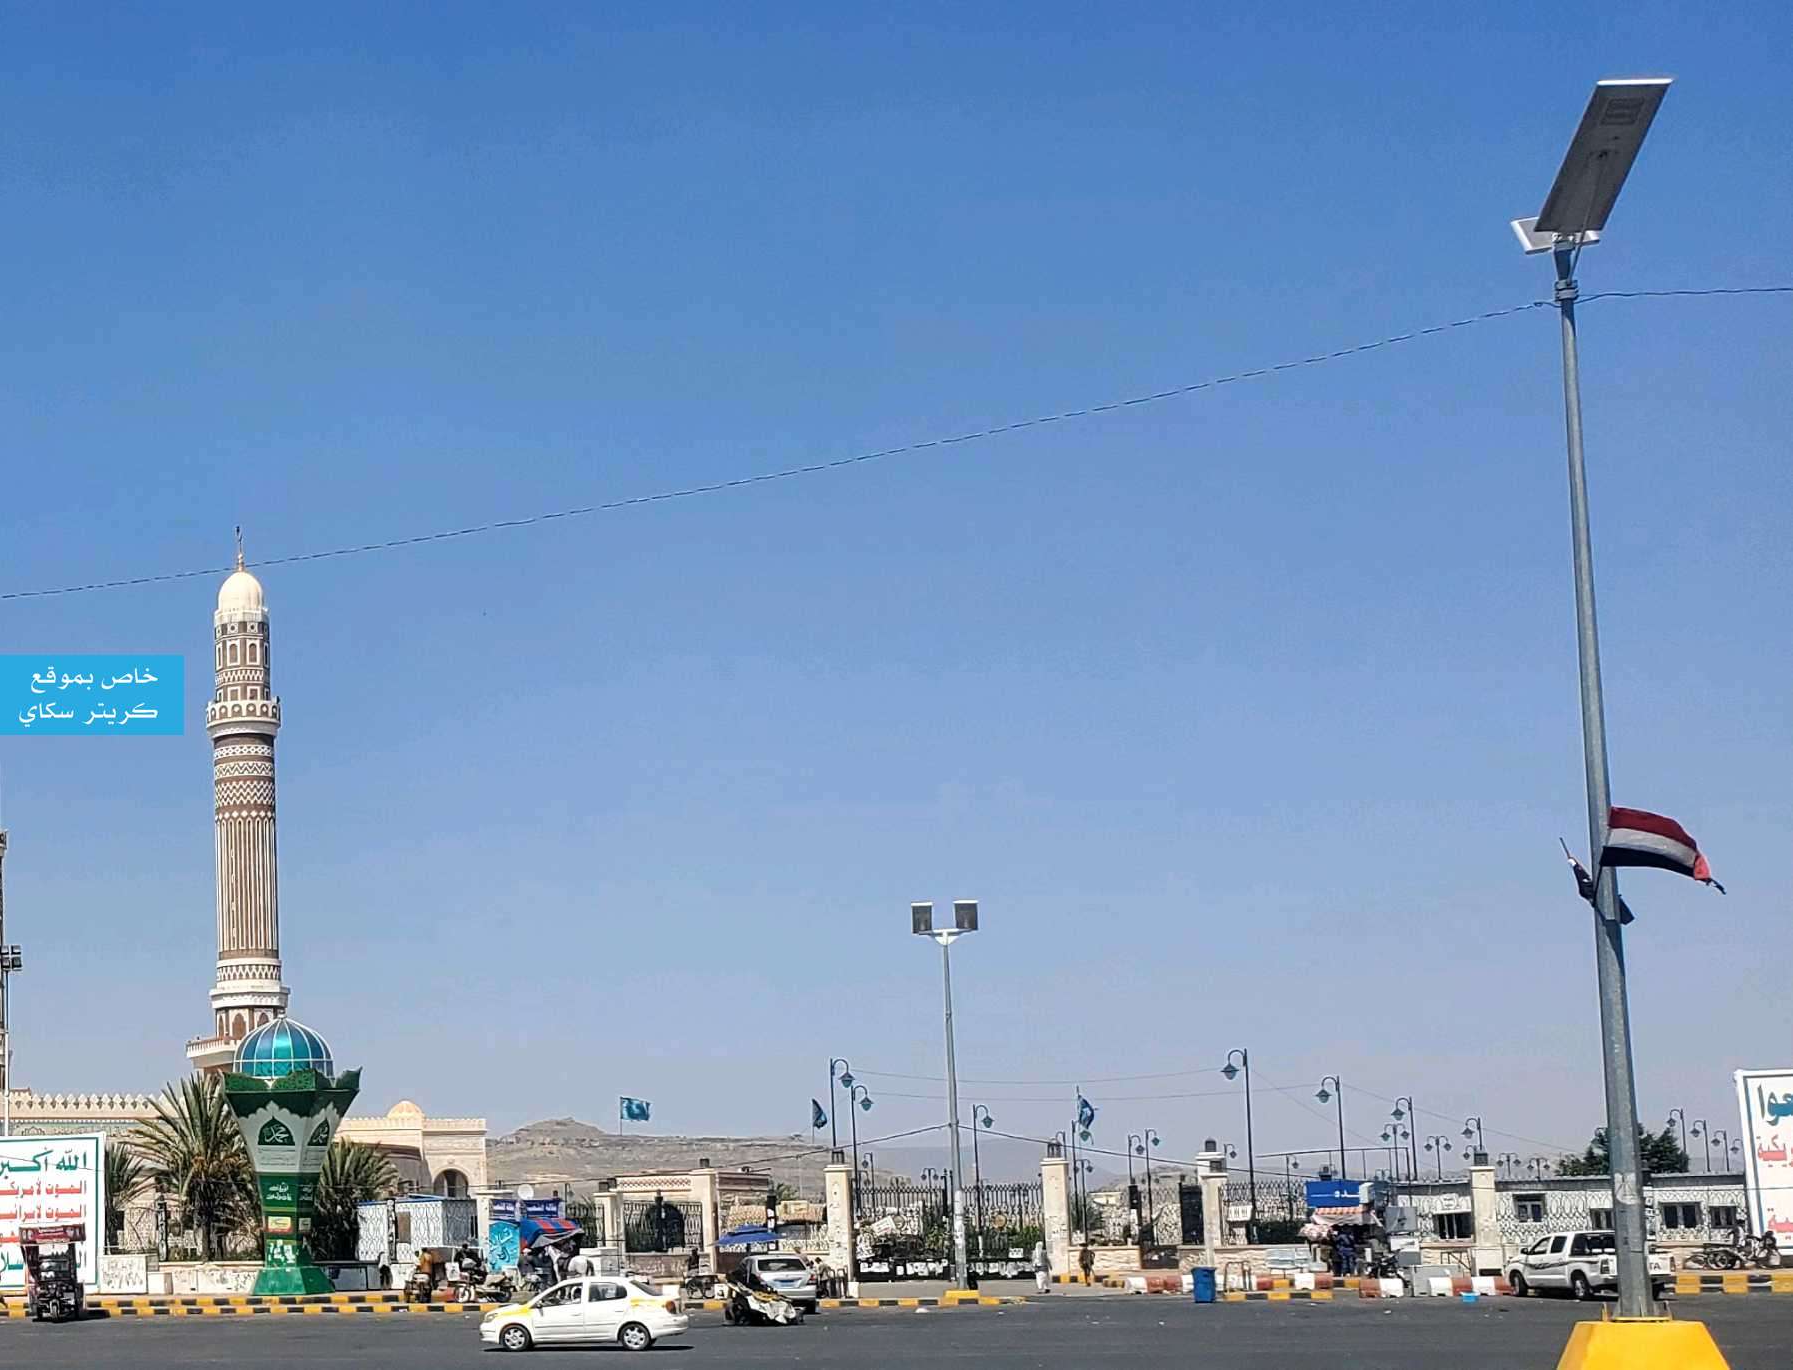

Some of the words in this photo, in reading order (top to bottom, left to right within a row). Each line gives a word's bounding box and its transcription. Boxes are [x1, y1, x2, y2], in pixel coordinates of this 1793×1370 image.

[1757, 1083, 1793, 1127] عوا
[55, 1148, 87, 1171] الله
[45, 1179, 87, 1198] الموت
[45, 1203, 87, 1223] الموت
